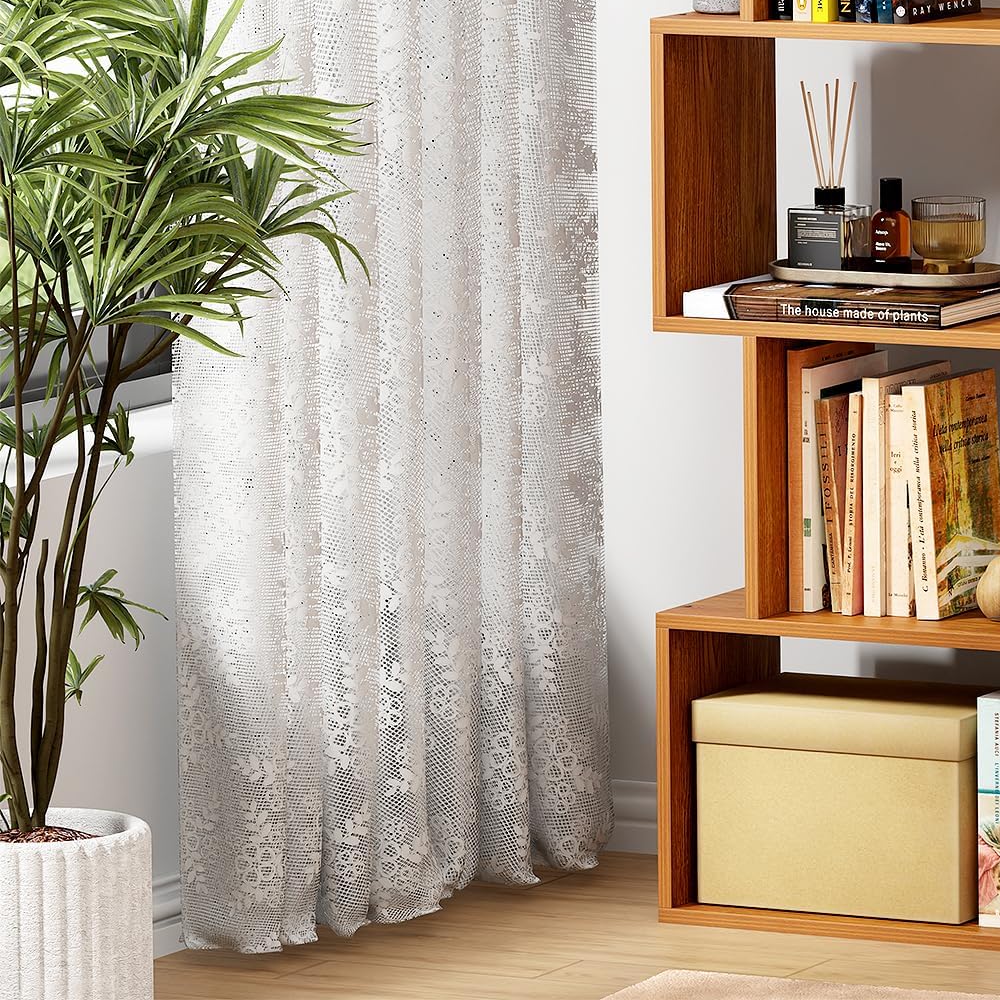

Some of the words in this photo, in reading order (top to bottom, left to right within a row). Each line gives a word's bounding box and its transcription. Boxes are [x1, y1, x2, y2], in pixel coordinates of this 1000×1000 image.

[912, 4, 932, 16] RAY
[781, 303, 802, 316] The
[804, 304, 840, 319] house
[843, 306, 874, 320] made
[878, 308, 891, 320] of
[892, 308, 929, 323] plants
[911, 433, 919, 454] critica
[819, 432, 832, 511] FOSSILI
